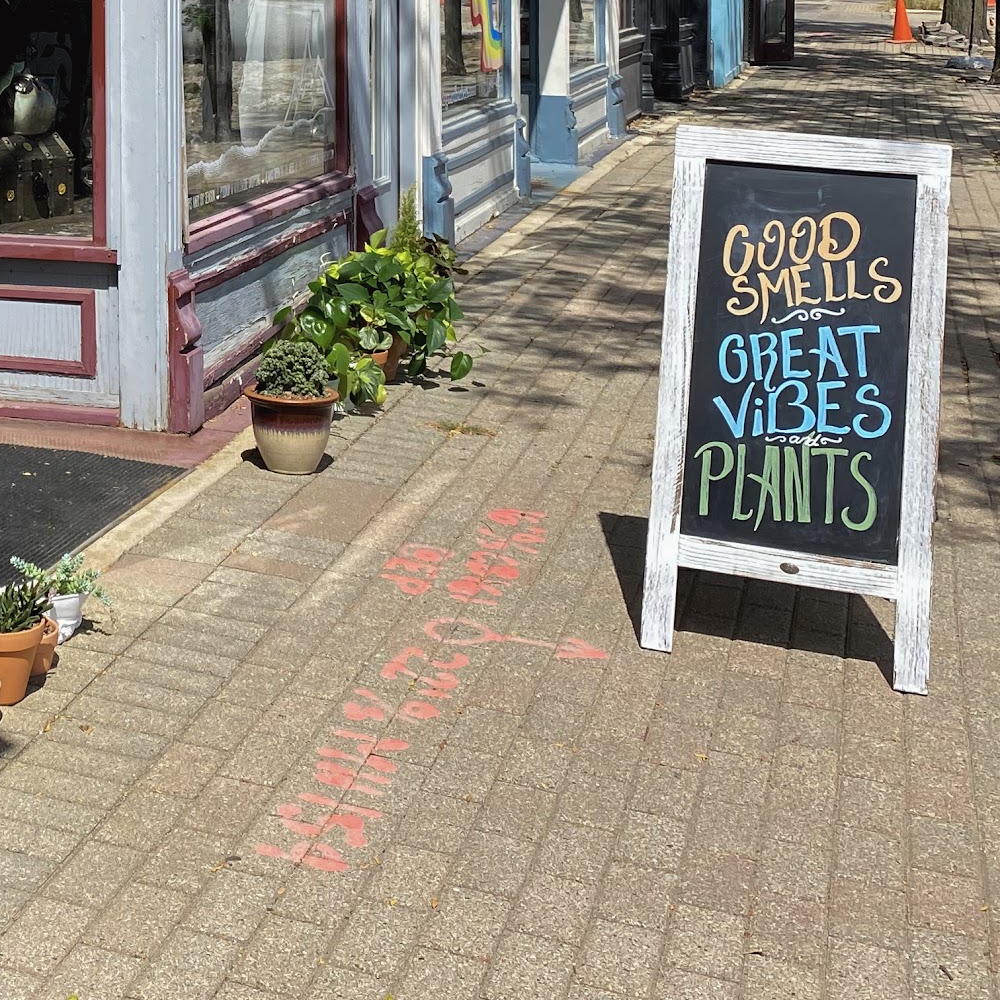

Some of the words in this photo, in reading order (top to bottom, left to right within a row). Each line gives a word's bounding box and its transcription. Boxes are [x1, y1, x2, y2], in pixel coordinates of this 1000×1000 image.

[723, 211, 861, 278] GOOD
[726, 256, 903, 325] SMELLS
[717, 325, 880, 392] GREAT
[694, 441, 878, 532] PLANTS
